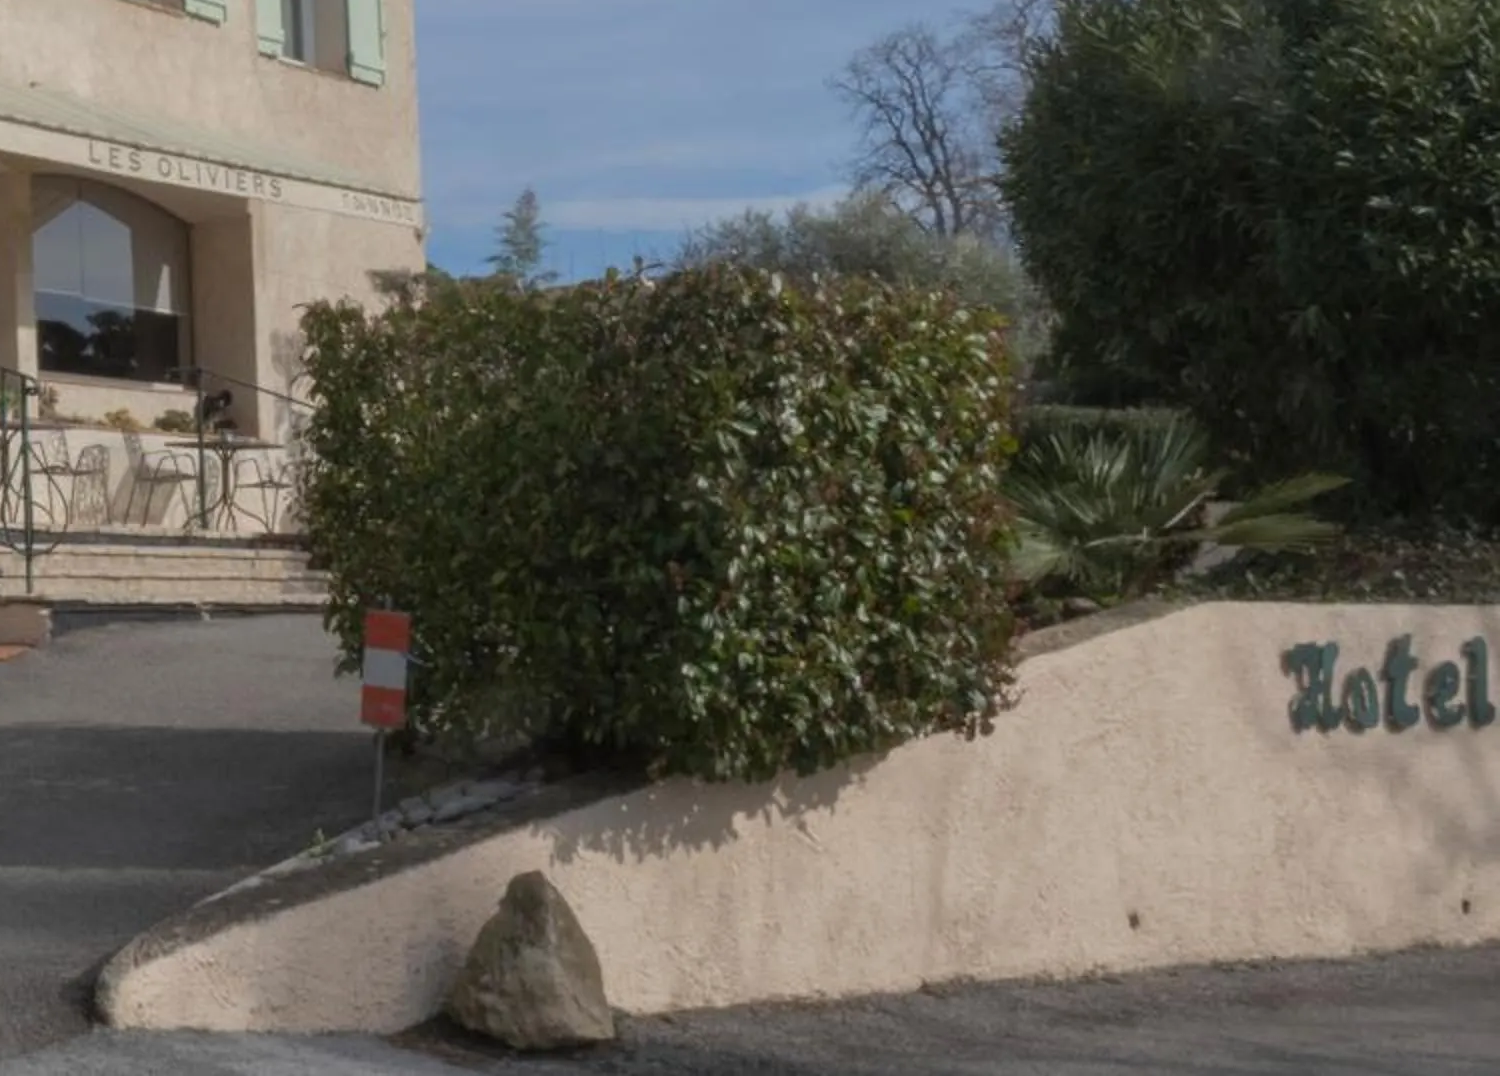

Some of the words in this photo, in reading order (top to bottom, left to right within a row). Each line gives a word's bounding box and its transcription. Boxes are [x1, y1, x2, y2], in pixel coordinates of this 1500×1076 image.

[87, 139, 142, 173] LES
[156, 156, 284, 200] OLIVIERS
[1279, 633, 1497, 734] Hotel
